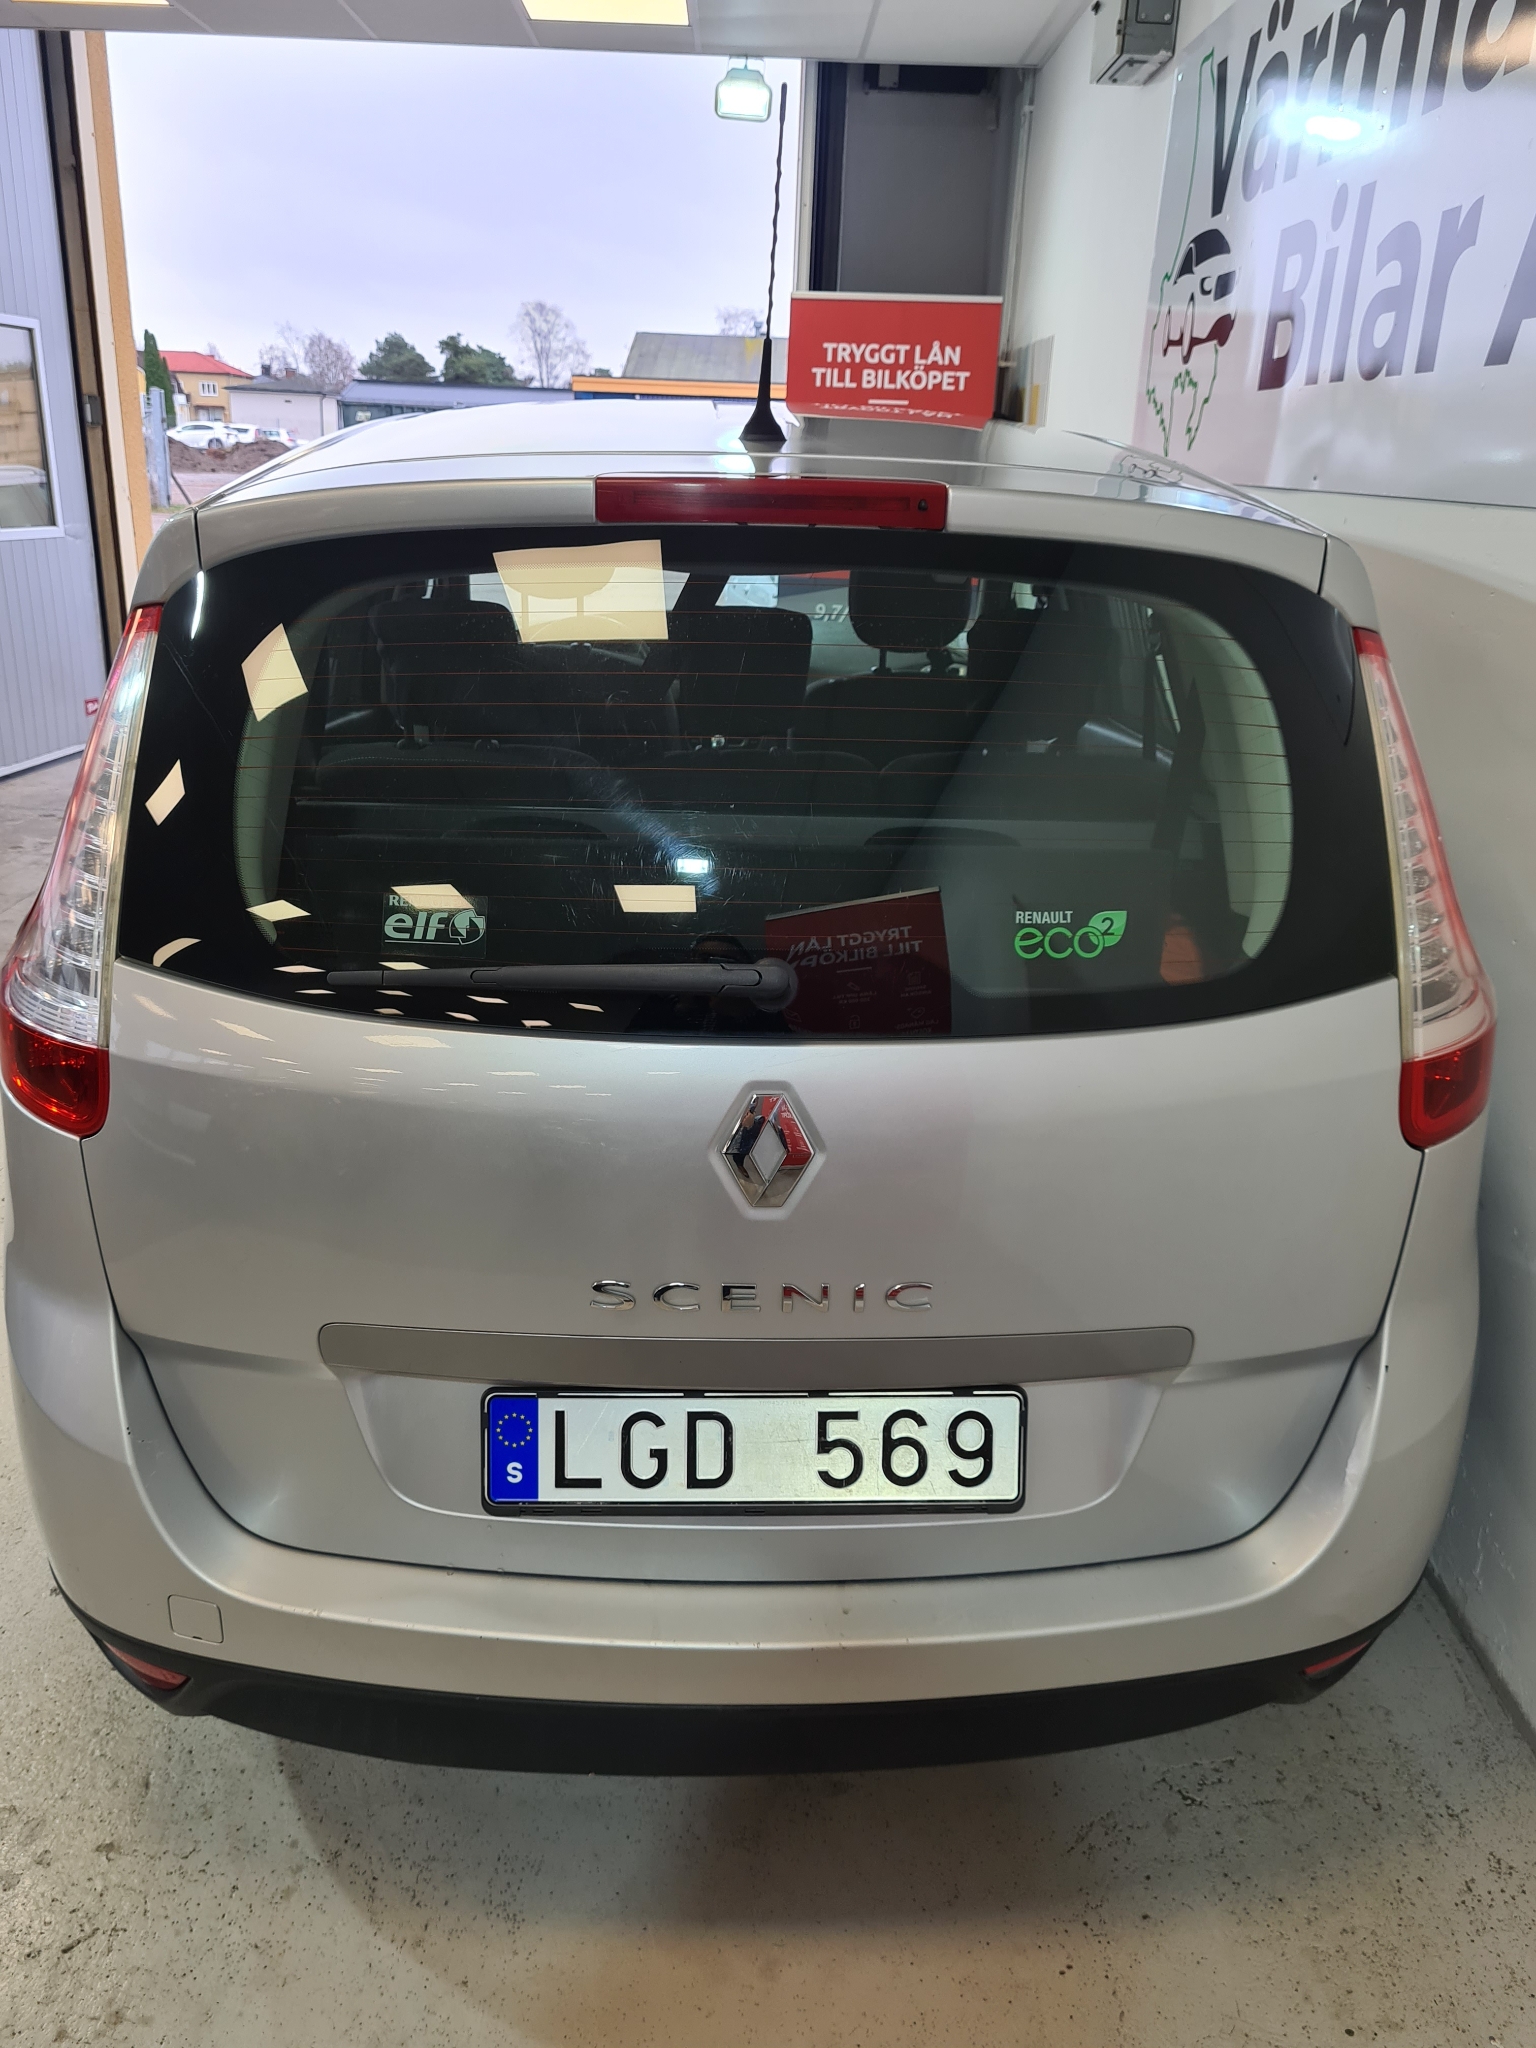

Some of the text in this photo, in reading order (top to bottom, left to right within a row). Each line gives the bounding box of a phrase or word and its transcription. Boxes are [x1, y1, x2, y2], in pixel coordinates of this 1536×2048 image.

[1257, 180, 1485, 392] Bilar
[822, 340, 962, 367] TRYGGT LÅN
[811, 365, 971, 392] TILL BILKÖPET
[384, 911, 449, 940] elf
[1015, 911, 1074, 924] RENAULT
[589, 1280, 934, 1312] SCENIC
[554, 1408, 994, 1489] LGD 569
[506, 1461, 523, 1484] S
